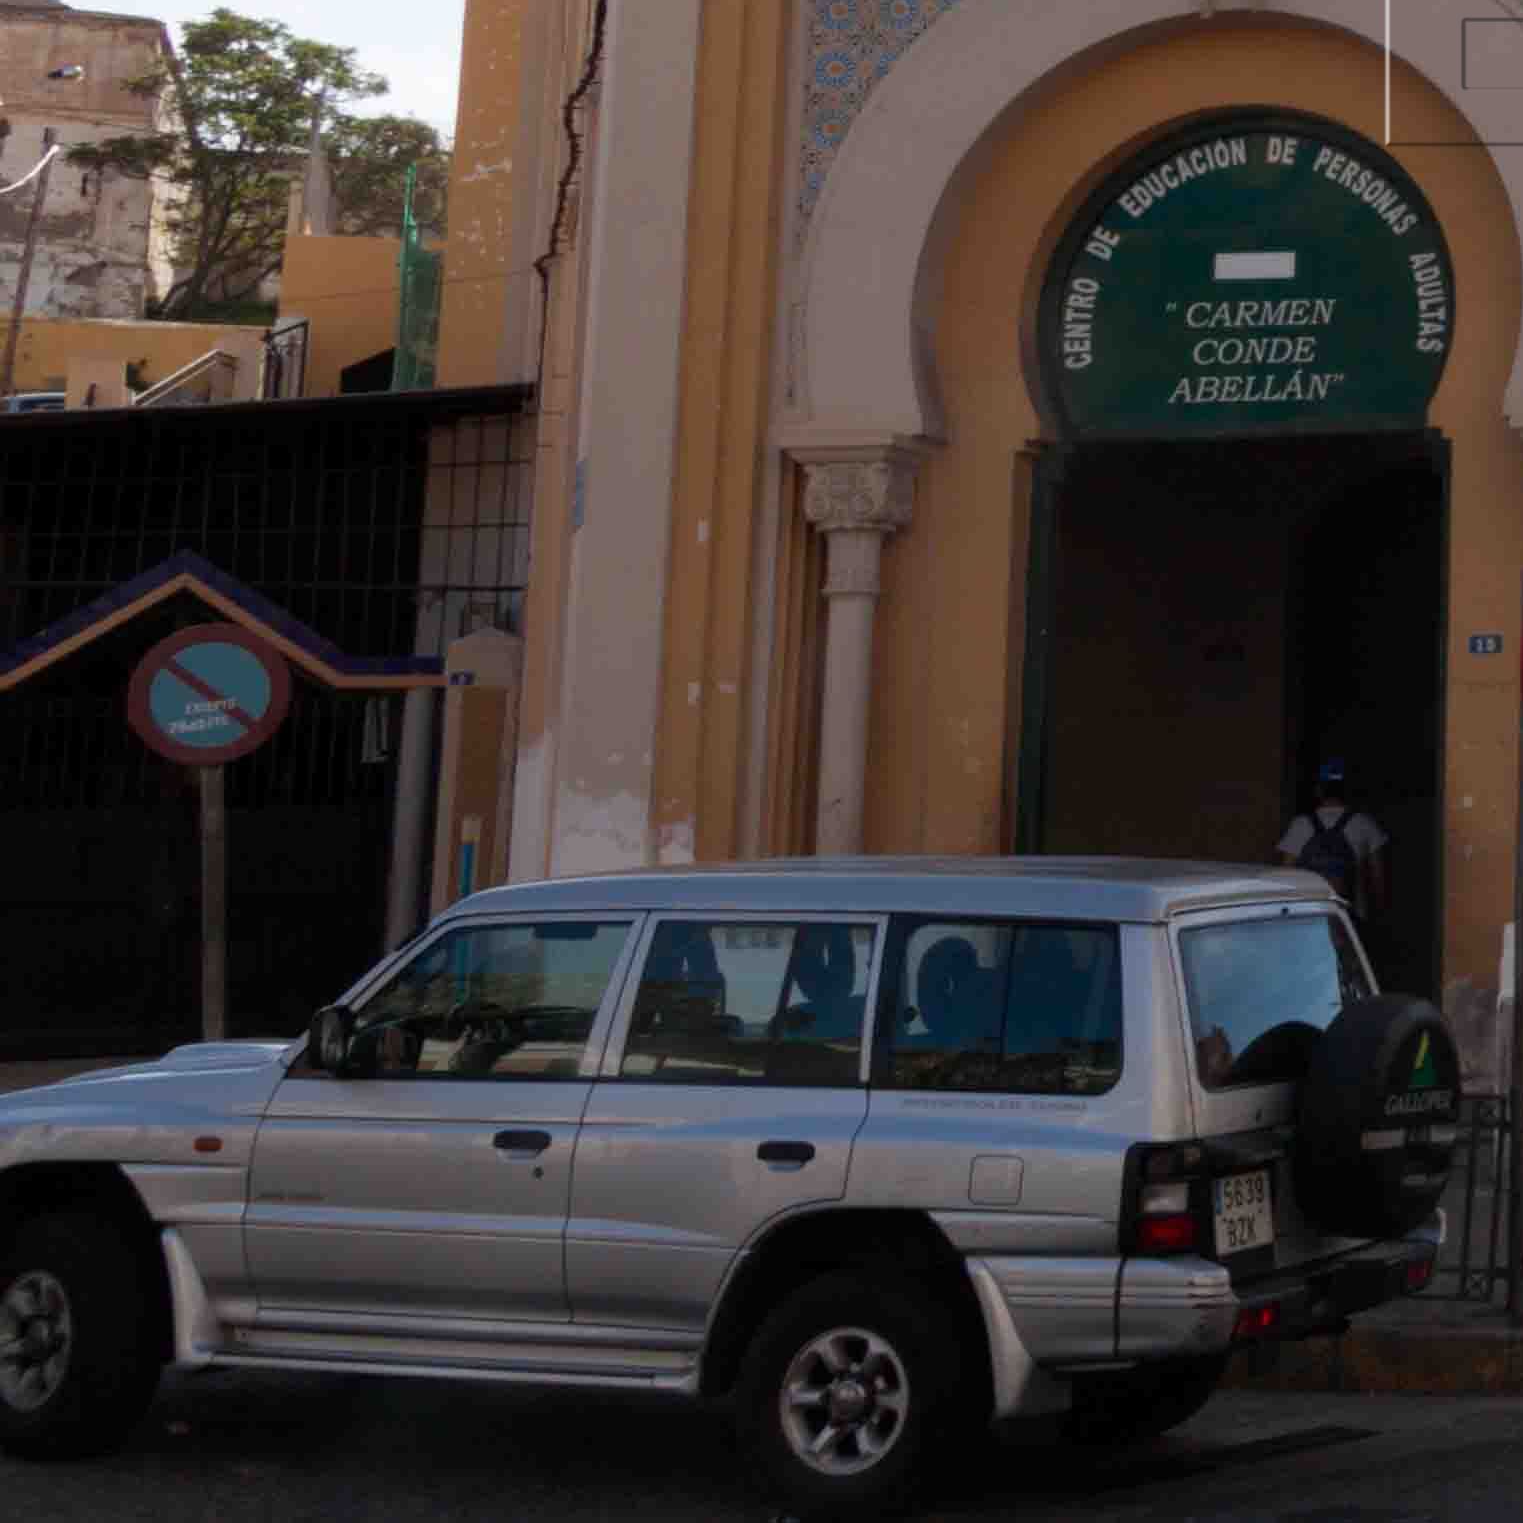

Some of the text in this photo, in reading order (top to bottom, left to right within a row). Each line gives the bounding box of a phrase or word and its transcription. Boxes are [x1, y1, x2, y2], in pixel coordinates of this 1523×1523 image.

[1063, 277, 1100, 369] CENTRO
[1086, 225, 1121, 262] DE
[1266, 136, 1298, 165] DE
[1313, 147, 1417, 236] PERSONAS
[1409, 251, 1447, 354] ADULTAS
[1192, 337, 1316, 366] CONDE
[1222, 1173, 1265, 1210] 5639
